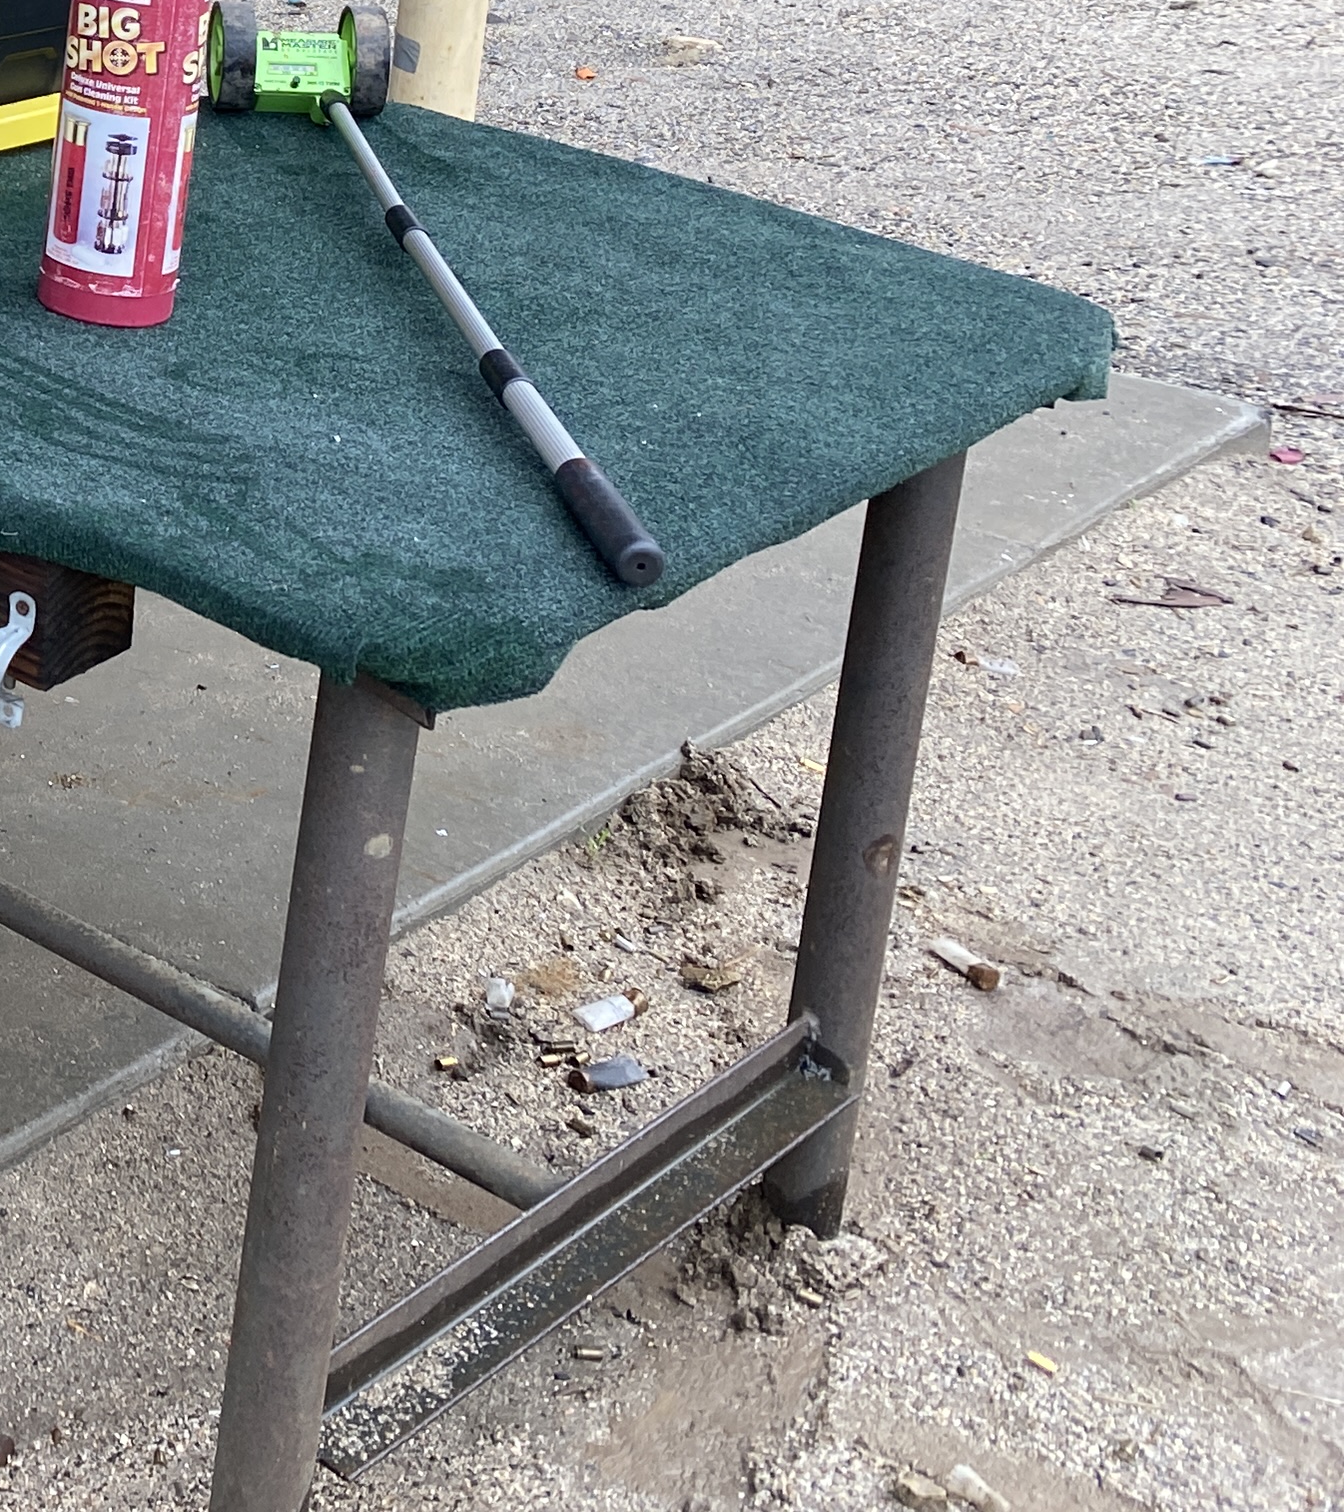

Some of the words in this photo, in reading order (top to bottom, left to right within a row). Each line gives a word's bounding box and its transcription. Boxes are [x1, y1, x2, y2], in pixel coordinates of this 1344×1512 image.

[78, 3, 141, 41] BIG
[66, 36, 165, 76] SHOT
[83, 86, 122, 104] Cleaning
[123, 93, 139, 105] Kit
[95, 79, 141, 95] Universal
